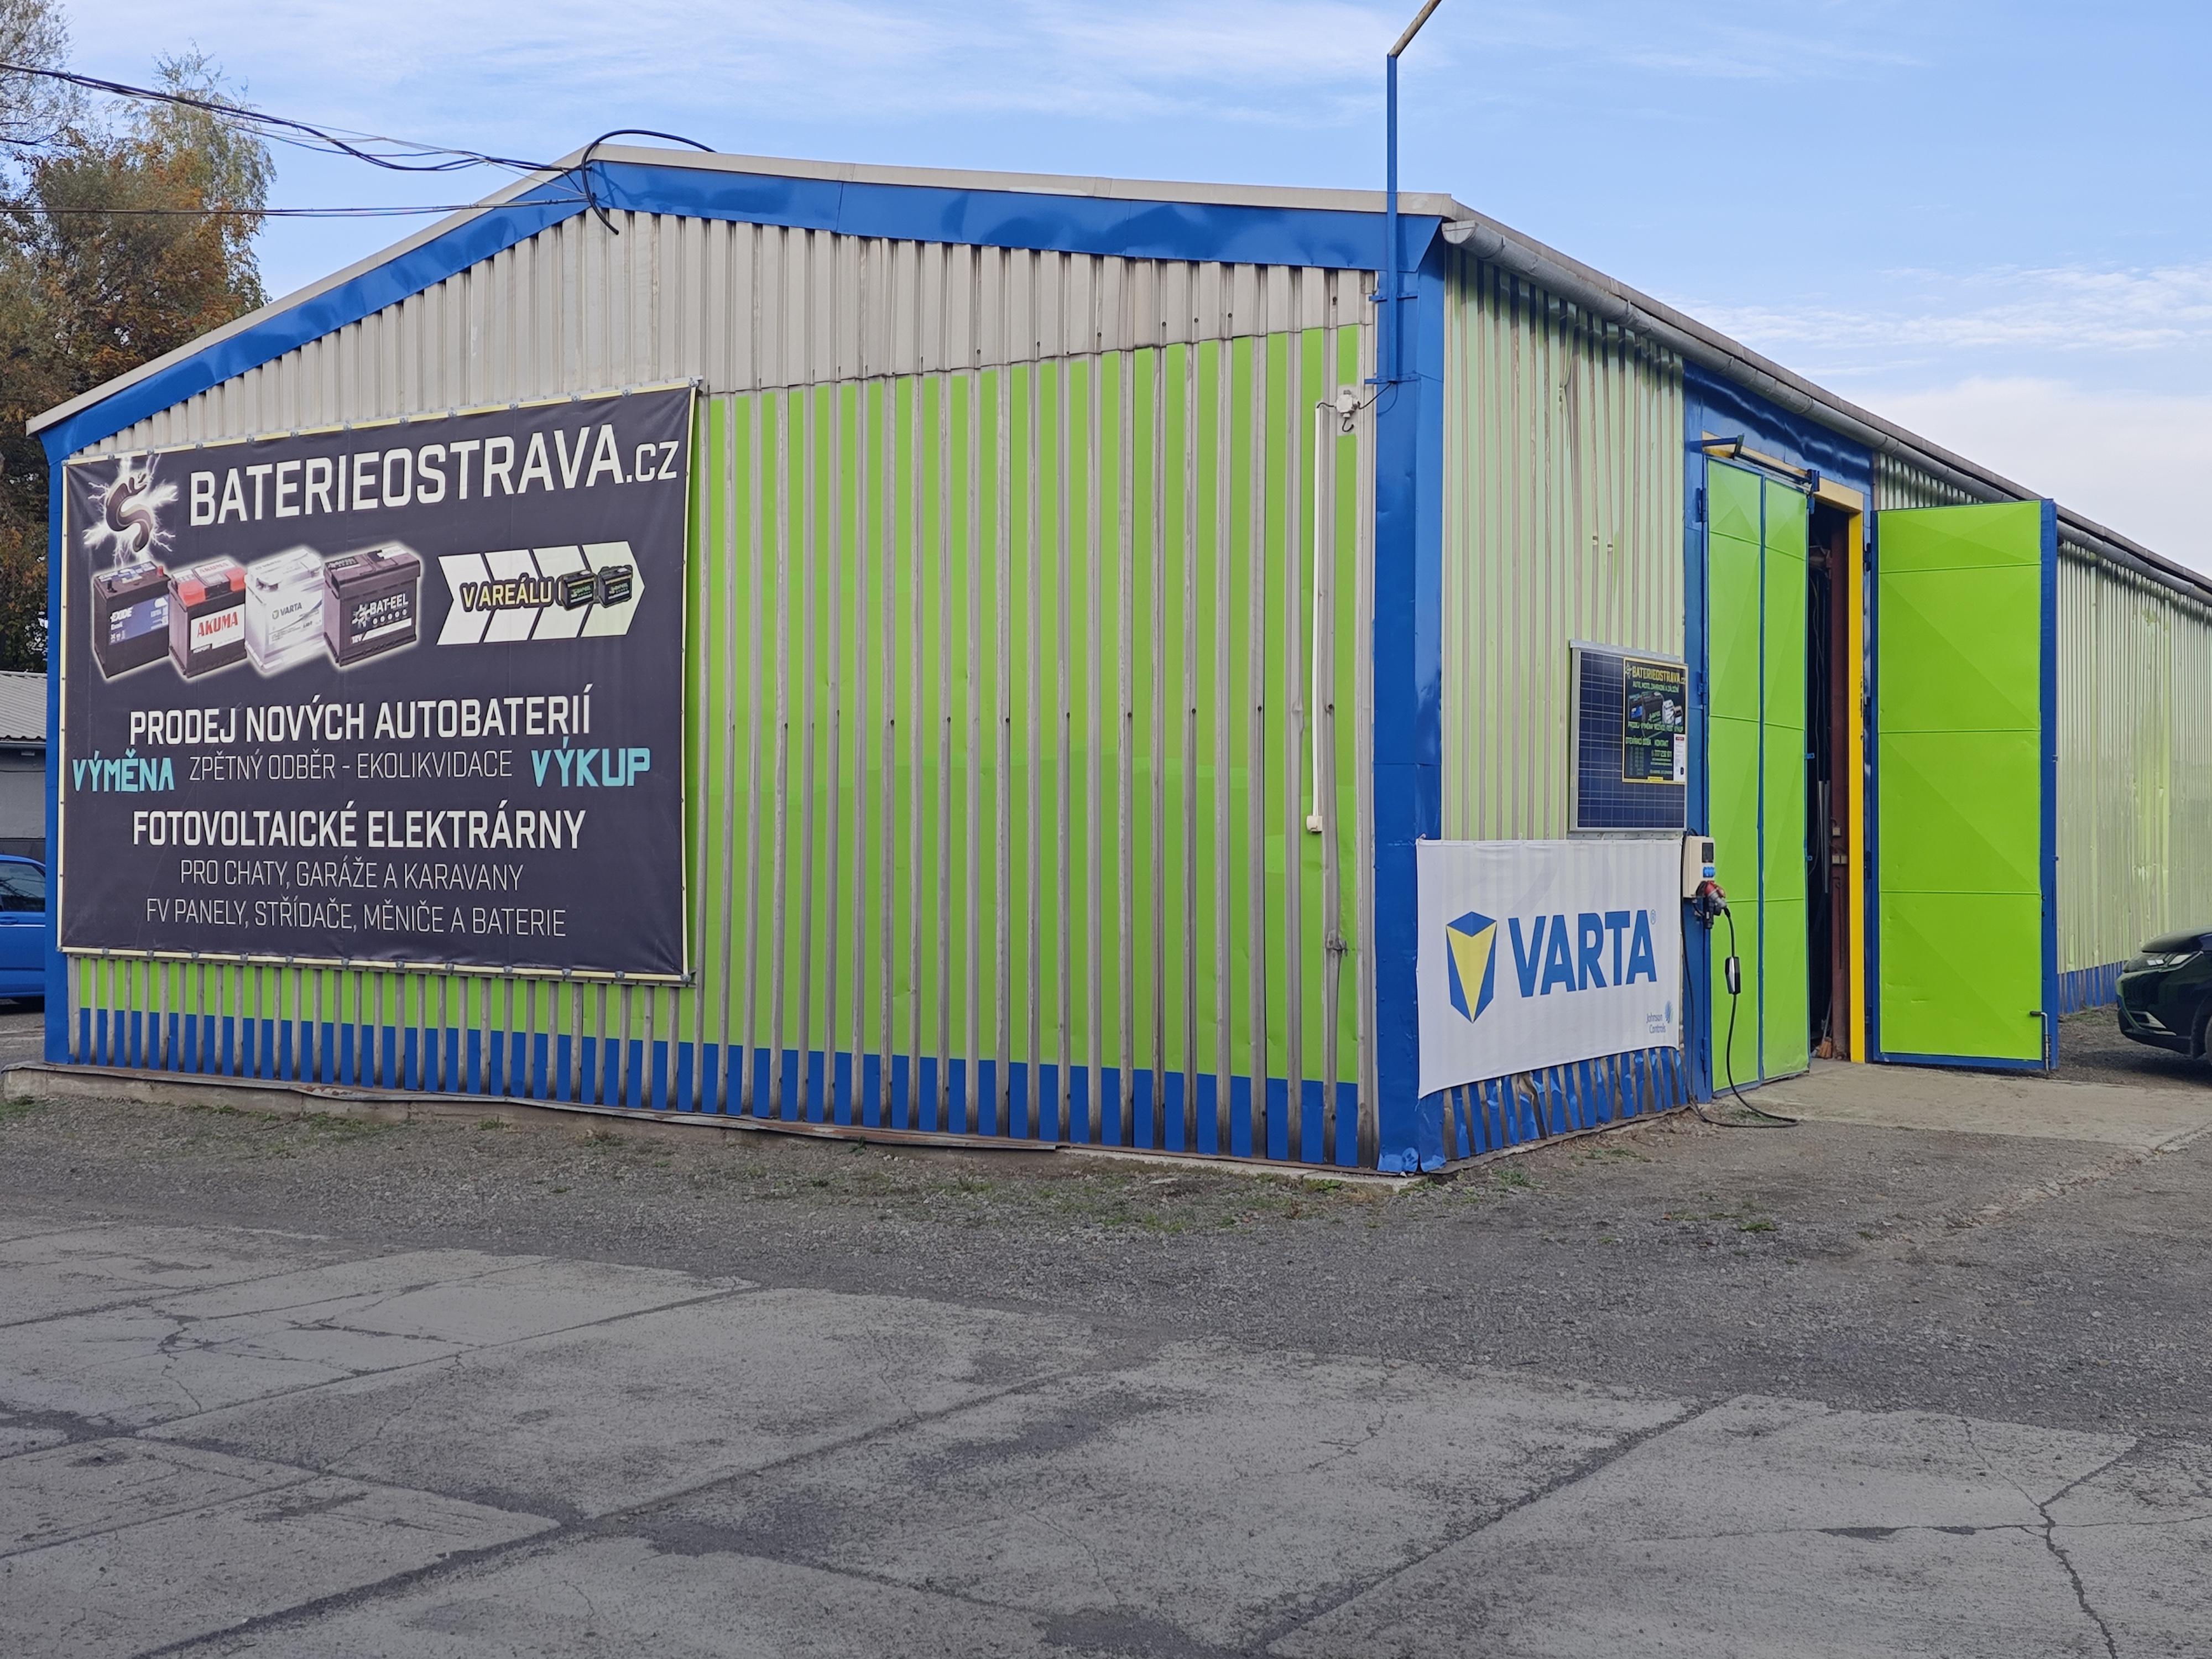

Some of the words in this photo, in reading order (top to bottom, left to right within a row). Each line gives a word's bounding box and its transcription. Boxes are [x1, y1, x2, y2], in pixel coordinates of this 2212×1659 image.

[280, 602, 303, 616] VARTA
[369, 593, 409, 615] BAT-EEL
[479, 576, 552, 607] AREÁLU
[197, 611, 238, 638] AKUMA
[129, 707, 236, 745] PRODEJ
[246, 695, 364, 743] NOVÝCH
[374, 683, 593, 739] AUTOBATERIÍ
[72, 748, 175, 792] VÝMĚNA
[188, 748, 264, 781] ZPĚTNÝ
[268, 748, 336, 780] ODBĚR
[357, 750, 513, 779] EKOLIKVIDACE
[530, 736, 651, 787] VÝKUP
[133, 800, 358, 848] FOTOVOLTAICKÉ
[367, 800, 587, 849] ELEKTRÁRNY
[180, 859, 218, 885] PRO
[224, 860, 291, 890] CHATY,
[296, 855, 378, 889] GARÁŽE
[383, 863, 398, 890] A
[404, 863, 524, 891] KARAVANY
[147, 898, 170, 923] FV
[174, 898, 249, 929] PANELY,
[254, 894, 357, 933] STŘÍDAČE,
[363, 899, 444, 933] MĚNIČE
[450, 907, 466, 933] A
[472, 907, 567, 937] BATERIE
[1507, 909, 1657, 998] VARTA
